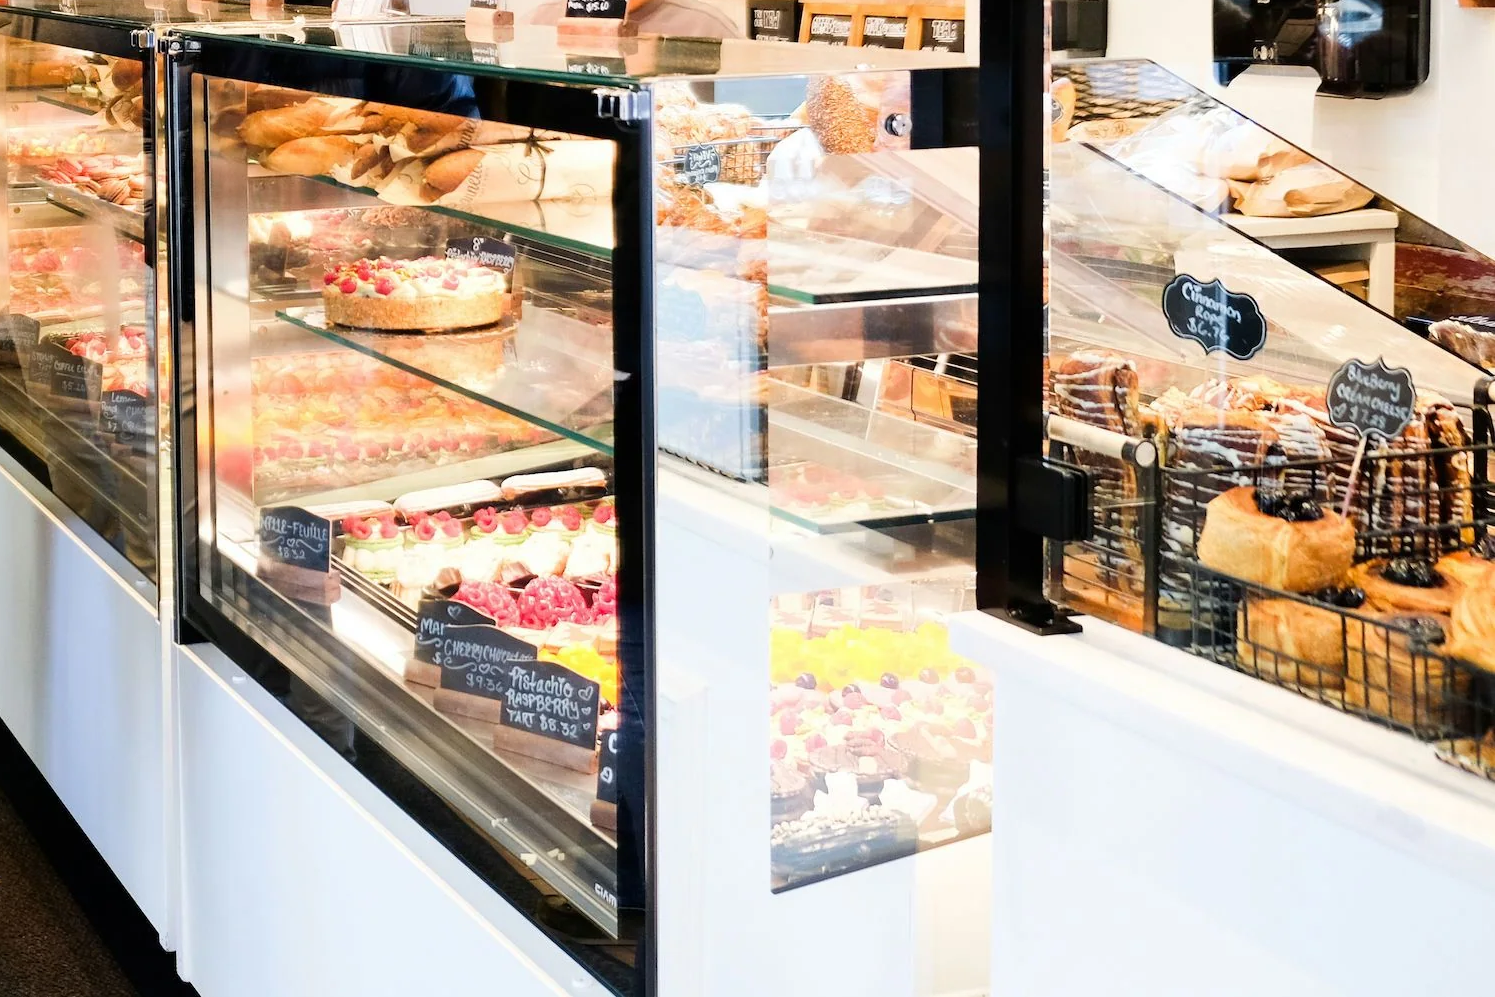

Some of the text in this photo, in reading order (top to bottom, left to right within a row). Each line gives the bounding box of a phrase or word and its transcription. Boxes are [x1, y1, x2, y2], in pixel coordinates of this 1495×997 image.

[504, 688, 580, 719] RASPBERRY
[505, 707, 579, 739] TART $8.32
